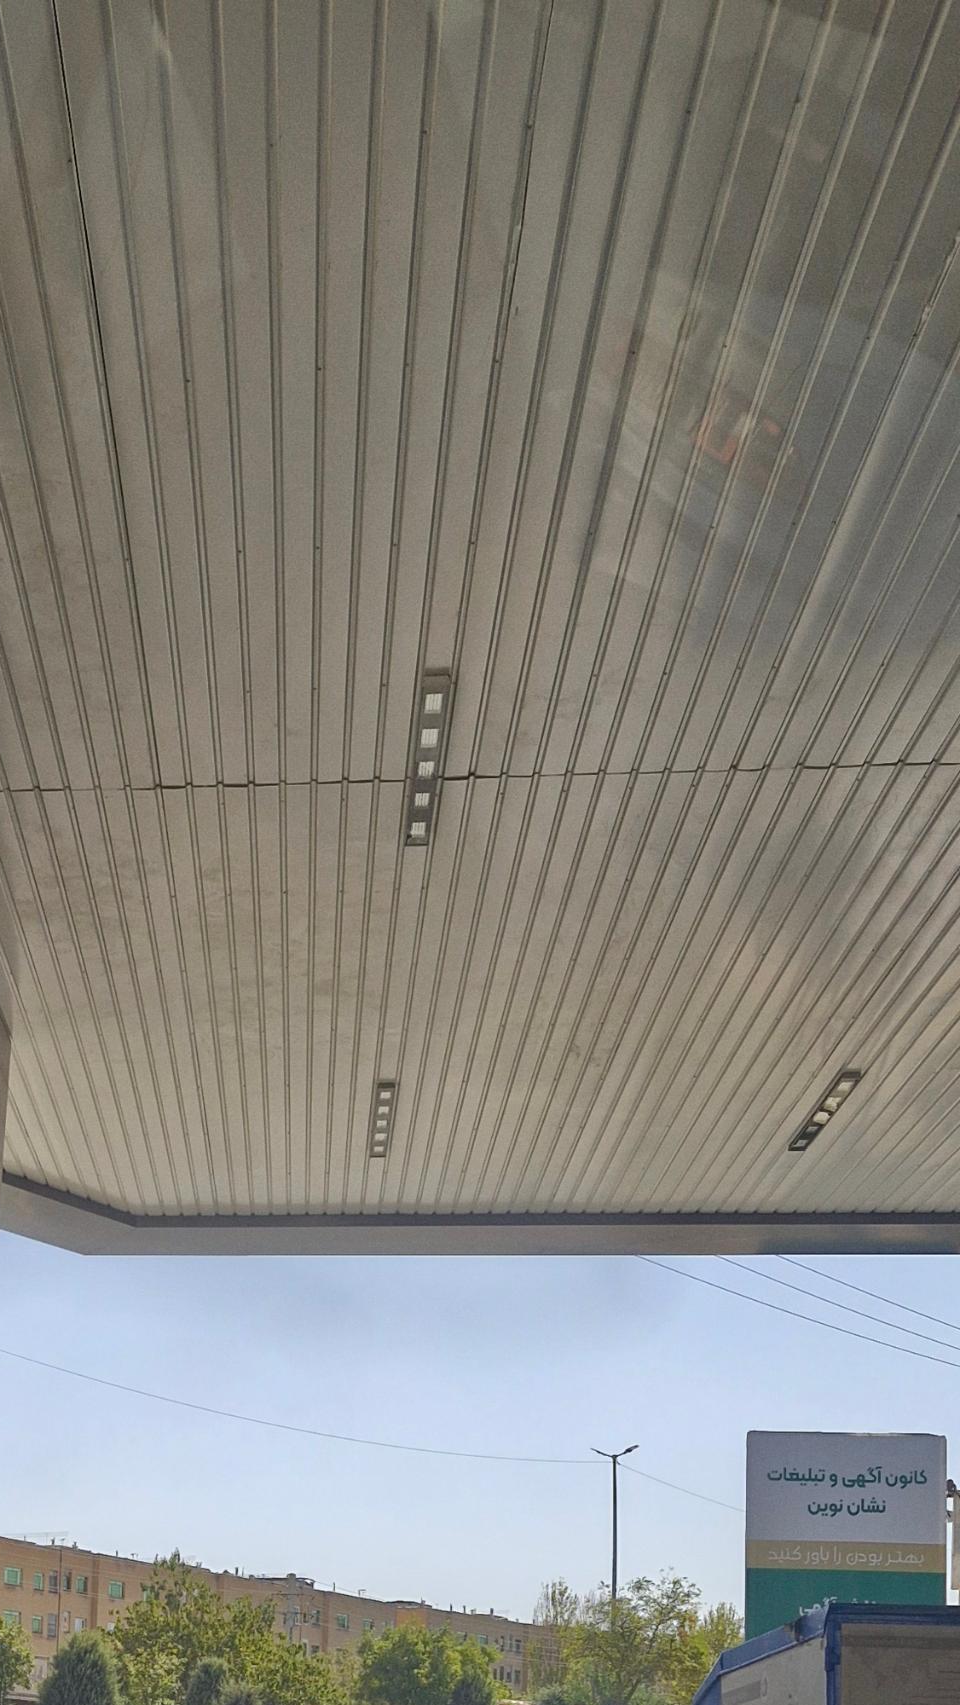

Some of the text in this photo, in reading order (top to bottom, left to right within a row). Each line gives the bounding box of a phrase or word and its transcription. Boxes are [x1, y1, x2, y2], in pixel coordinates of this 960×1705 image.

[767, 1466, 928, 1489] کانون آگهی و تبلیغات
[807, 1497, 887, 1517] نشان نوین
[833, 1545, 842, 1564] را
[846, 1550, 883, 1566] بودن
[886, 1552, 925, 1567] بهتر
